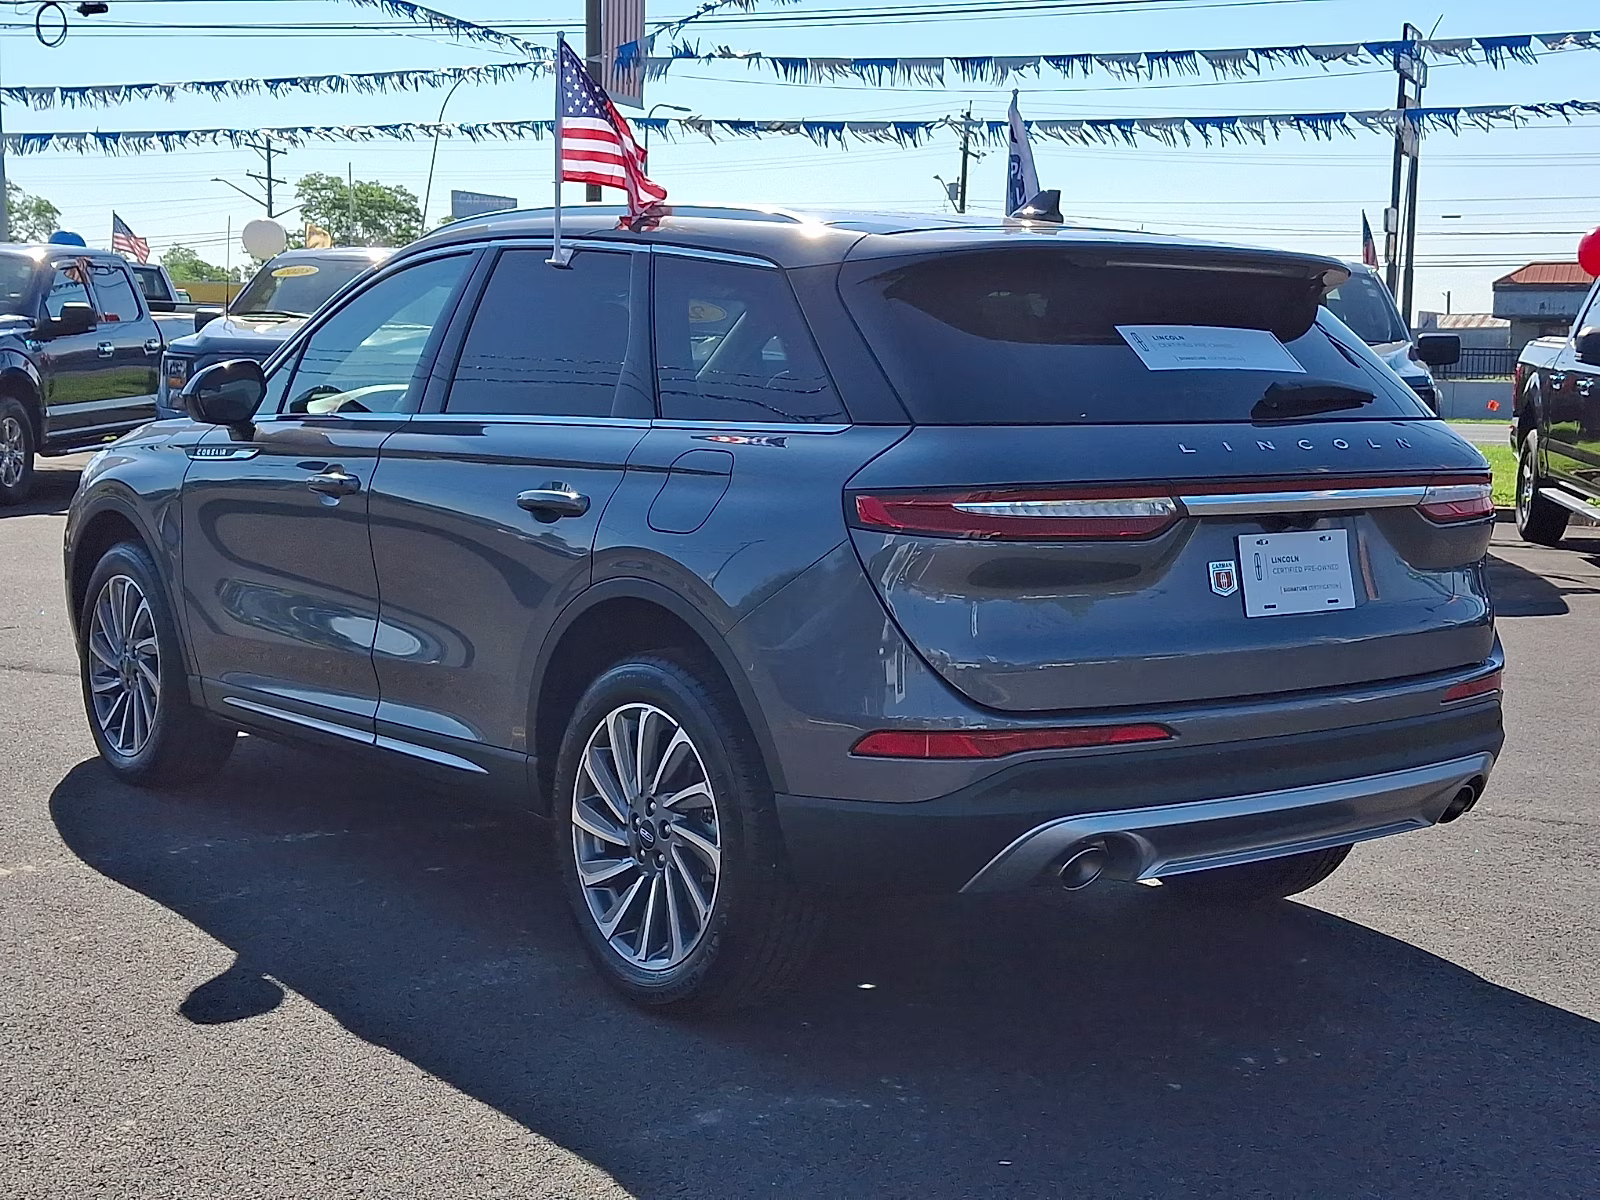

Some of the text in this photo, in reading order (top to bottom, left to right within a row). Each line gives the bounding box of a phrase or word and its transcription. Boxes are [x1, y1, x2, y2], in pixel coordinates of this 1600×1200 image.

[1178, 438, 1412, 454] LINCOLN
[196, 448, 227, 456] CORSAIR
[1271, 556, 1300, 564] LINCOLN
[1273, 564, 1339, 574] CERTIFIED PRE-OWNED
